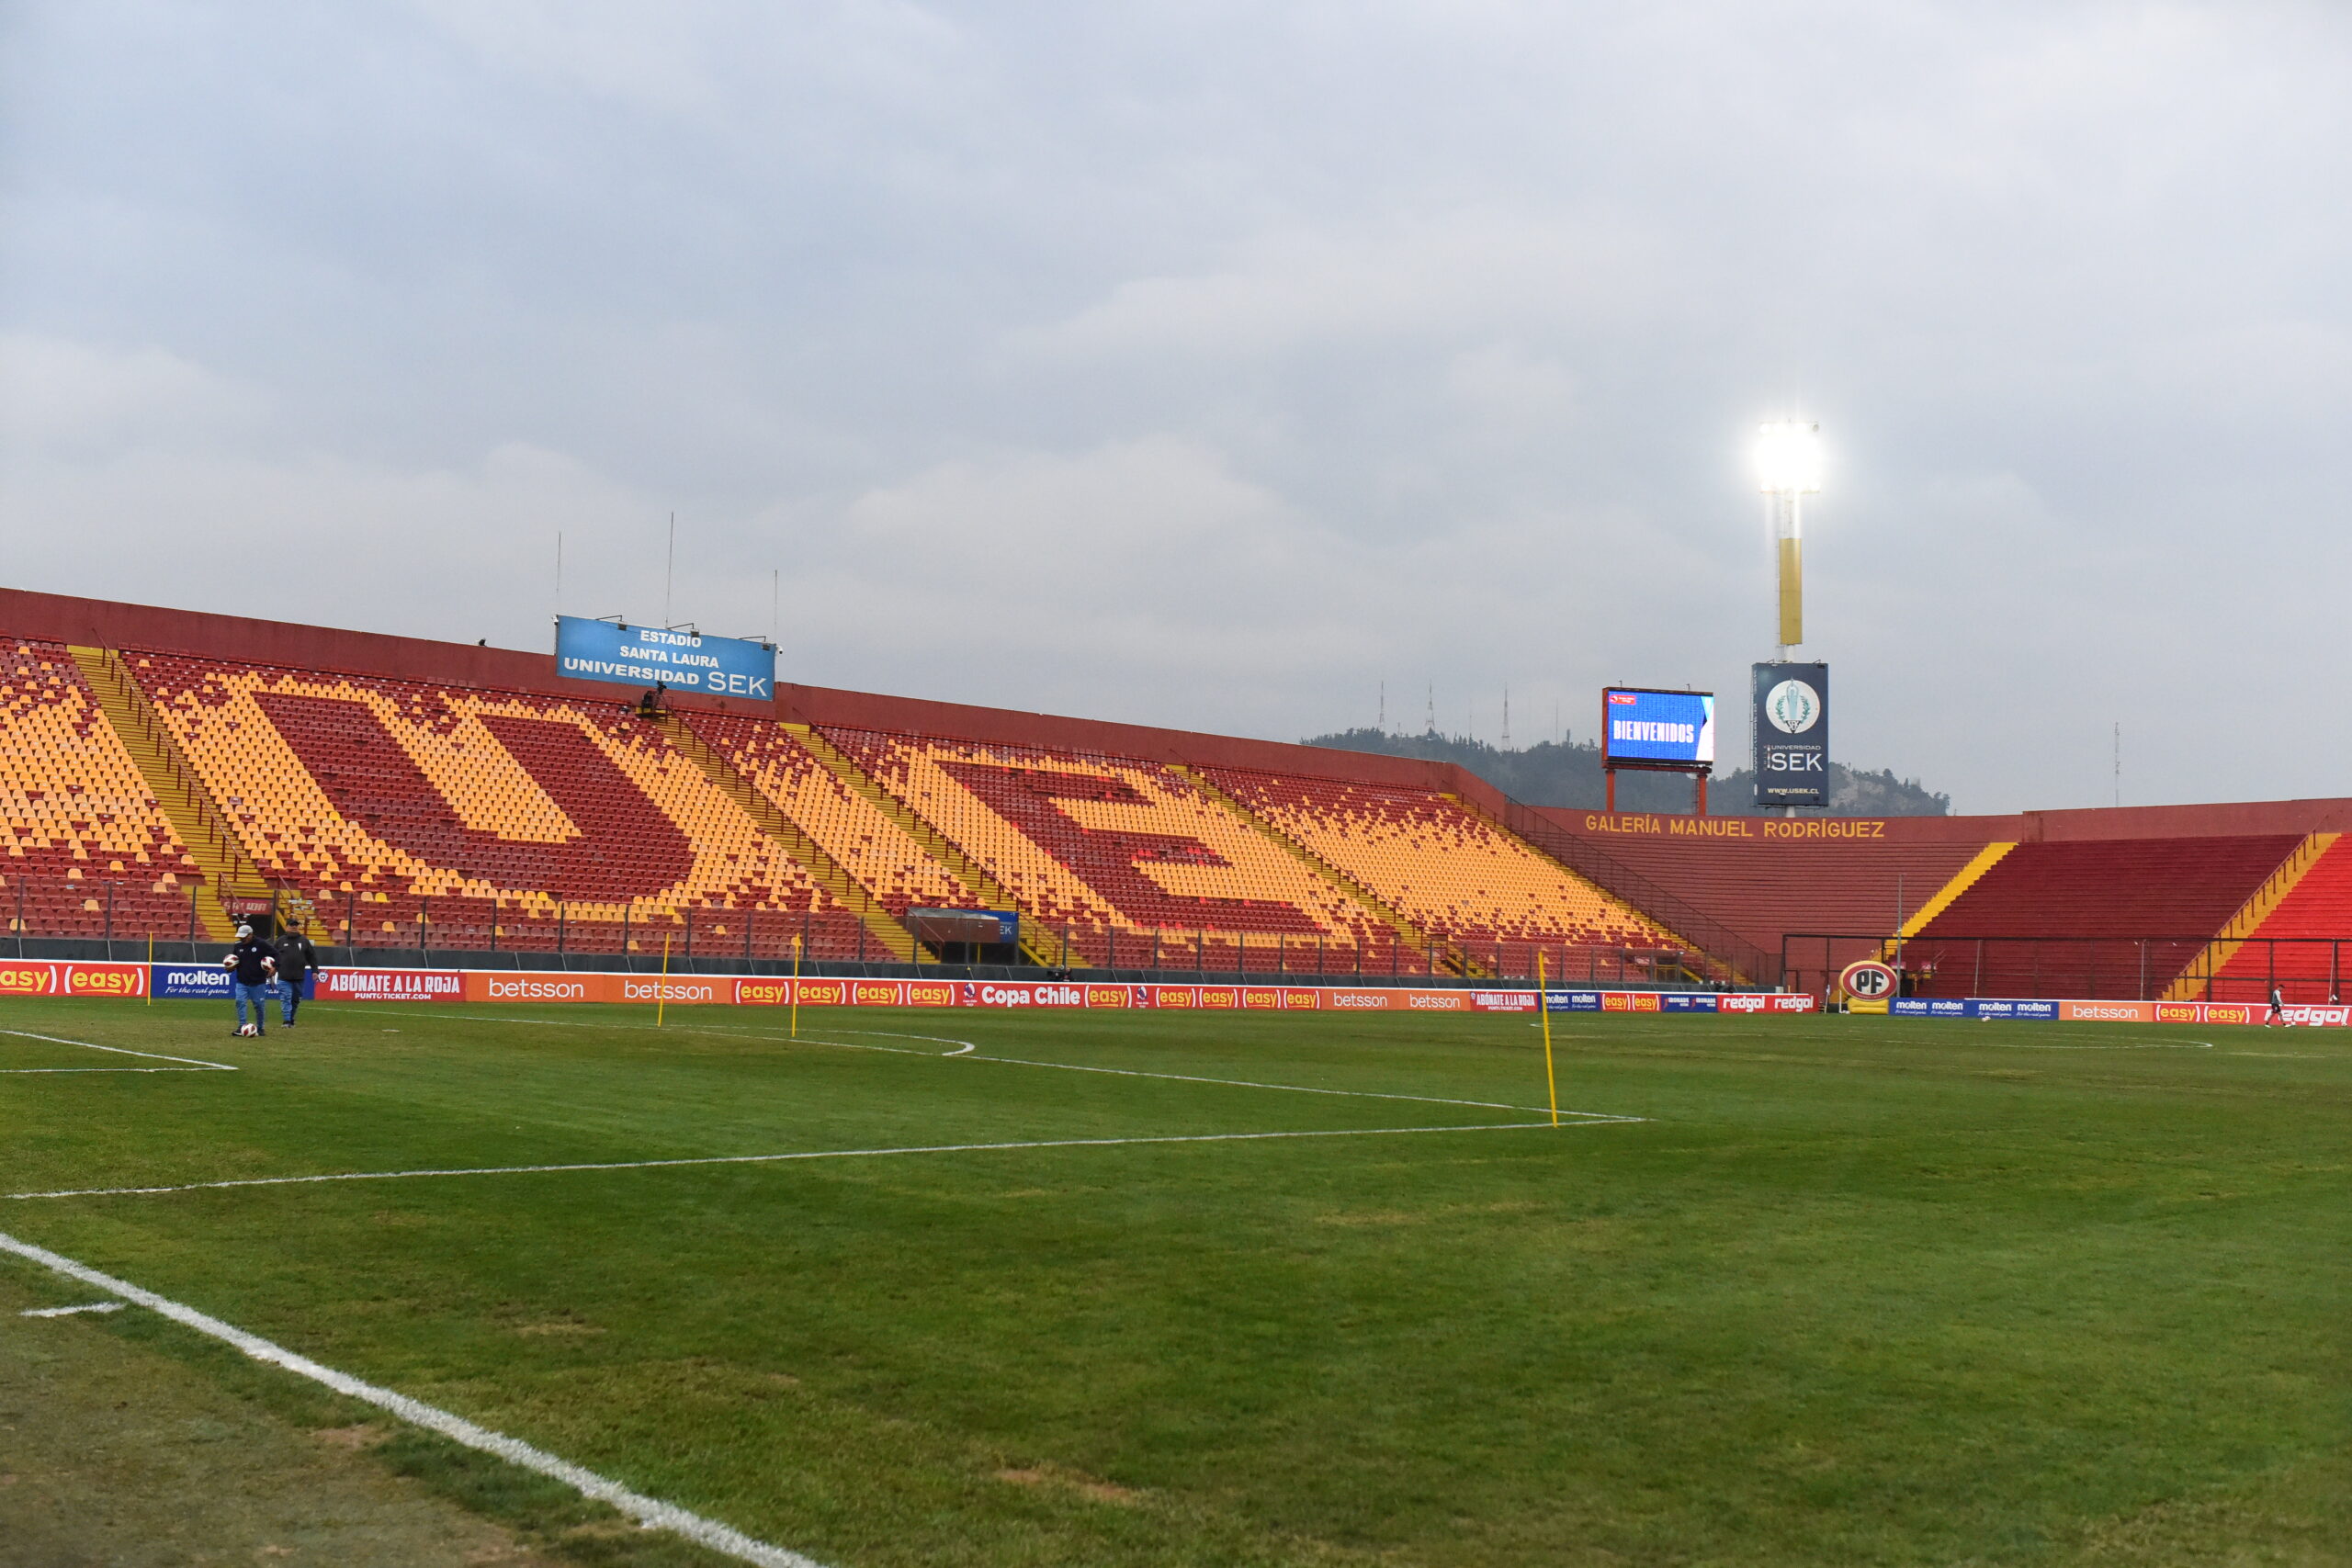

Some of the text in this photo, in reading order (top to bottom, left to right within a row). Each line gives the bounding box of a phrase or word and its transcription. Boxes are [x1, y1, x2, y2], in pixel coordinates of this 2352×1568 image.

[639, 629, 702, 649] ESTADIO
[619, 646, 719, 669] SANTA LAURA
[564, 657, 767, 697] UNIVERSIDAD SEK
[1613, 720, 1694, 743] BIENVENIDOS
[1771, 752, 1823, 772] SEK
[1586, 814, 1885, 838] GALERÍA MANUEL RODRÍGUEZ
[168, 970, 230, 986] molten
[330, 972, 460, 994] ABÓNATE A LA ROJA
[1856, 970, 1884, 994] PF
[489, 978, 584, 998] betsson
[625, 980, 712, 1000] betsson
[981, 986, 1080, 1008] Copa Chile
[1334, 992, 1387, 1007] betsson
[1409, 993, 1460, 1008] betsson
[1510, 994, 1519, 1006] LA
[1572, 994, 1596, 1004] molten
[1723, 996, 1765, 1012] redgol
[1775, 996, 1814, 1012] redgol
[1896, 1001, 1927, 1010] molten
[1932, 1001, 1963, 1010] molten
[1978, 1002, 2012, 1011] molten
[2018, 1003, 2051, 1011] molten
[2073, 1005, 2138, 1019] betsson
